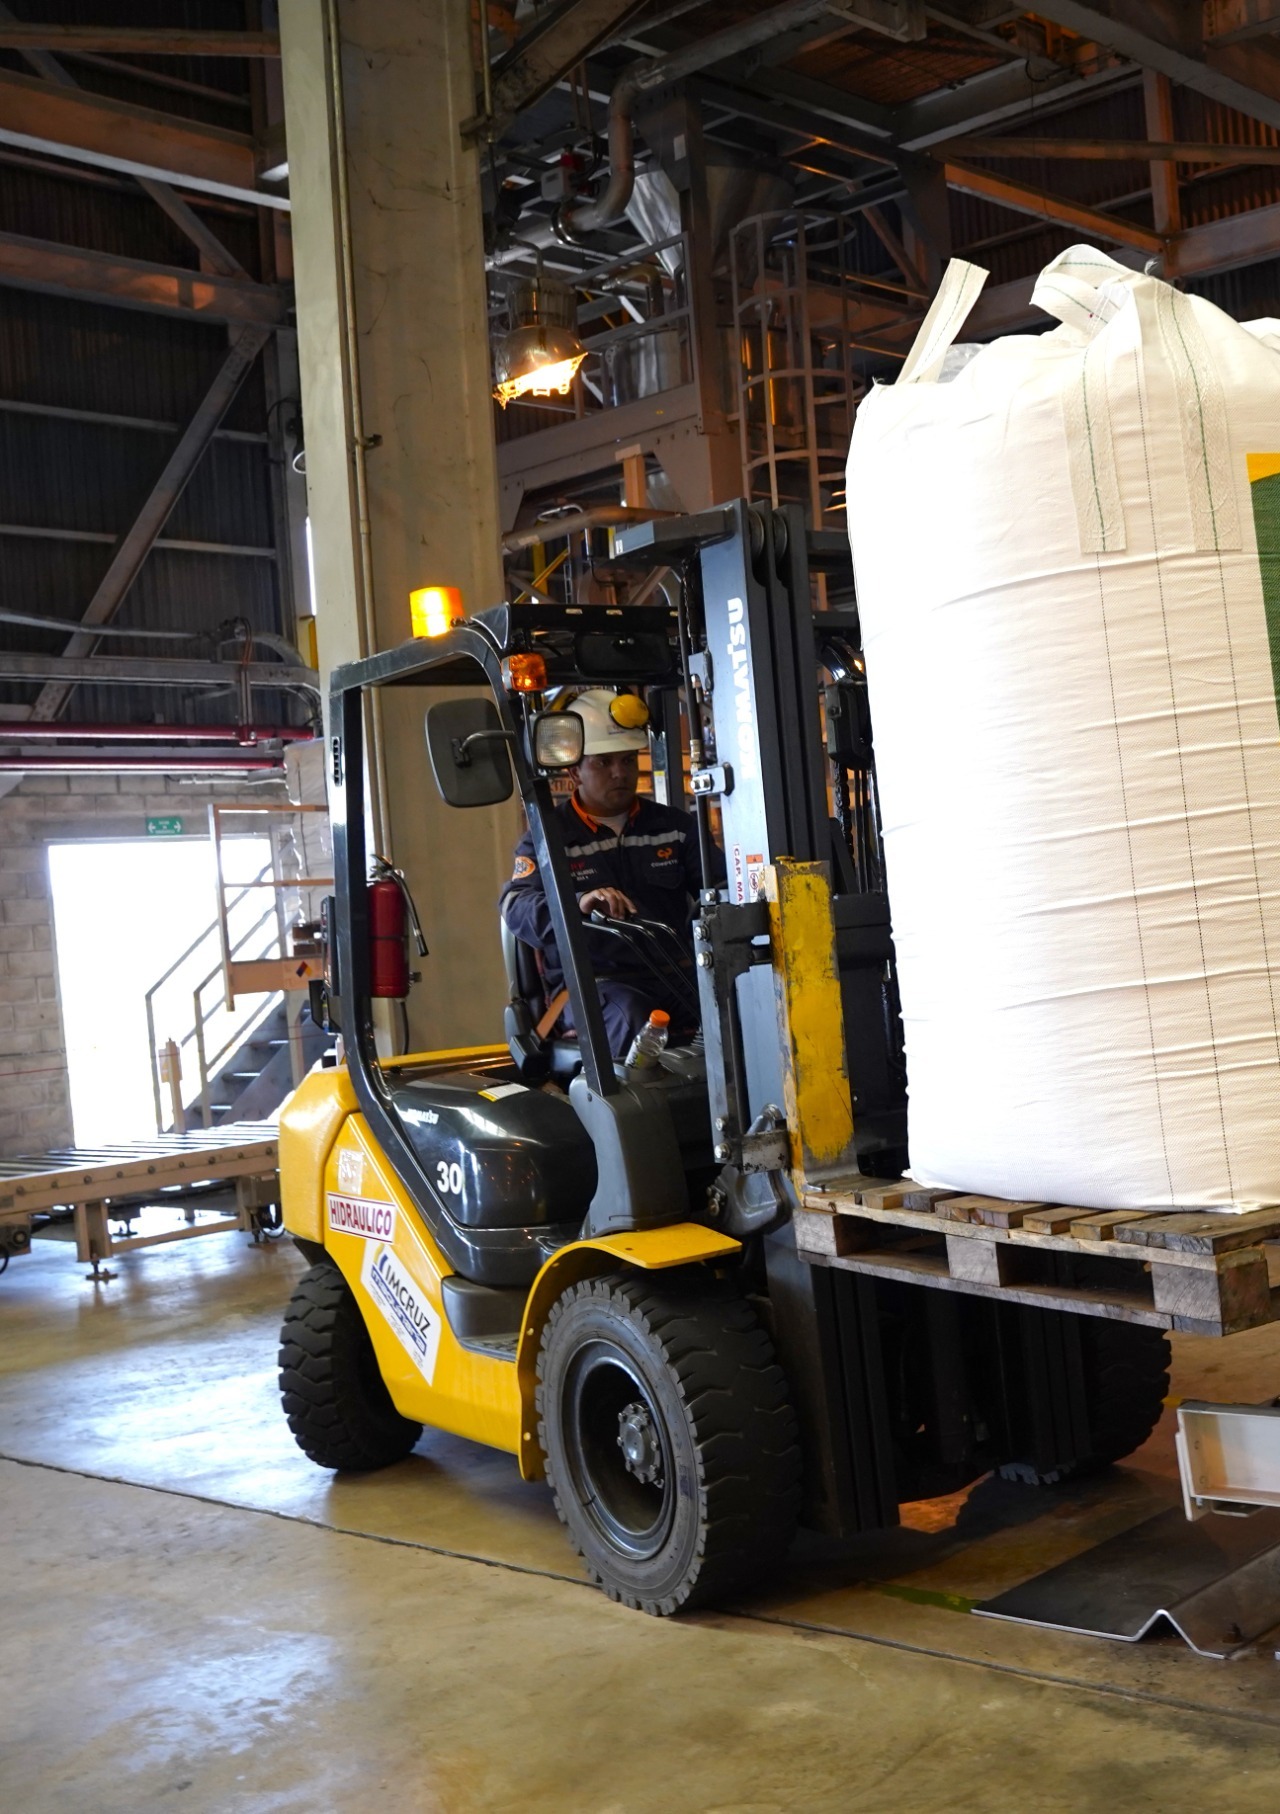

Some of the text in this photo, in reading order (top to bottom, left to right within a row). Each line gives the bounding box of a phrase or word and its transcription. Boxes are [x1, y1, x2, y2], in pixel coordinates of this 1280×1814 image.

[727, 597, 757, 781] KOMATSU
[436, 1160, 463, 1195] 30
[329, 1199, 393, 1236] HIDRAULICO
[385, 1264, 431, 1339] IMCRUZ
